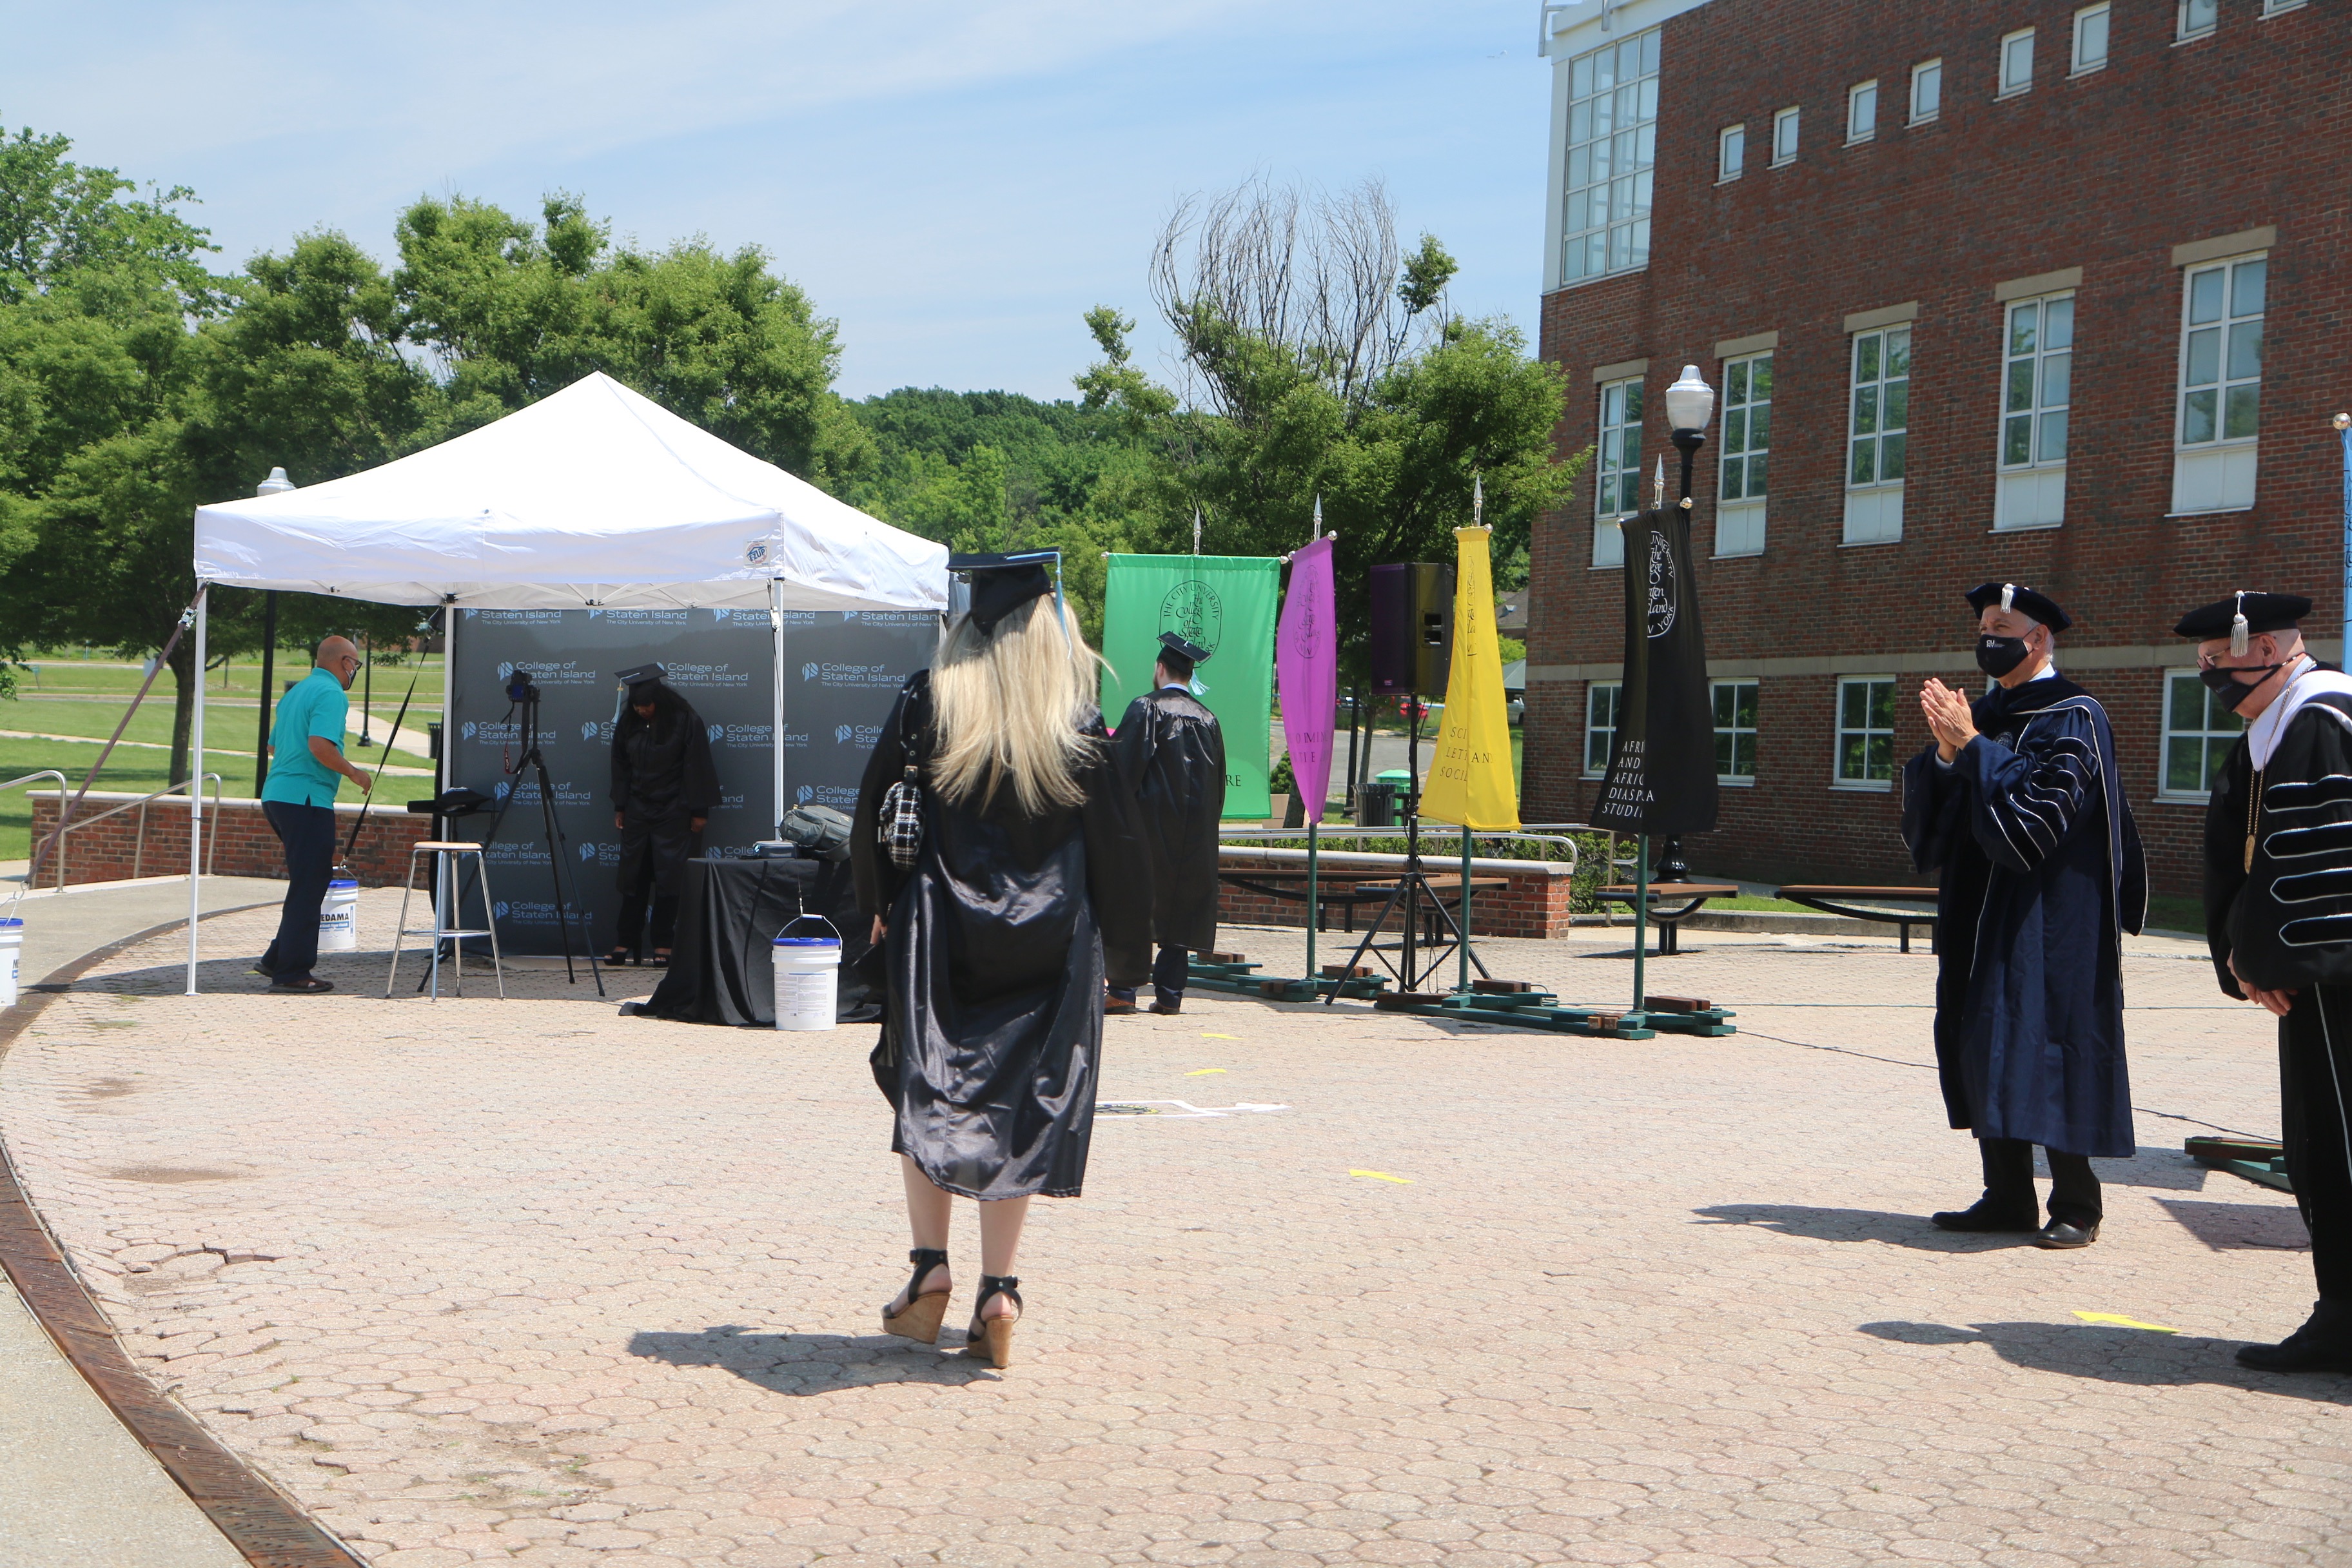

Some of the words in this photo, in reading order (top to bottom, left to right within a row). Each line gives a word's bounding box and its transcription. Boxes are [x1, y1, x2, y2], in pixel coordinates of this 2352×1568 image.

[1164, 602, 1173, 618] THE
[1171, 586, 1188, 600] CITY
[607, 610, 647, 618] Staten
[652, 611, 687, 619] Island
[516, 662, 560, 671] College
[668, 663, 712, 673] College
[822, 663, 867, 674] College
[667, 671, 708, 680] Staten
[821, 672, 864, 681] Staten
[868, 673, 905, 681] Island
[727, 724, 772, 734] College
[1622, 740, 1645, 753] AFRI
[1618, 757, 1640, 769] AND
[513, 790, 542, 799] State
[725, 846, 754, 854] Colle
[599, 852, 620, 860] Sta
[511, 901, 555, 912] College
[320, 913, 349, 921] EDAMA
